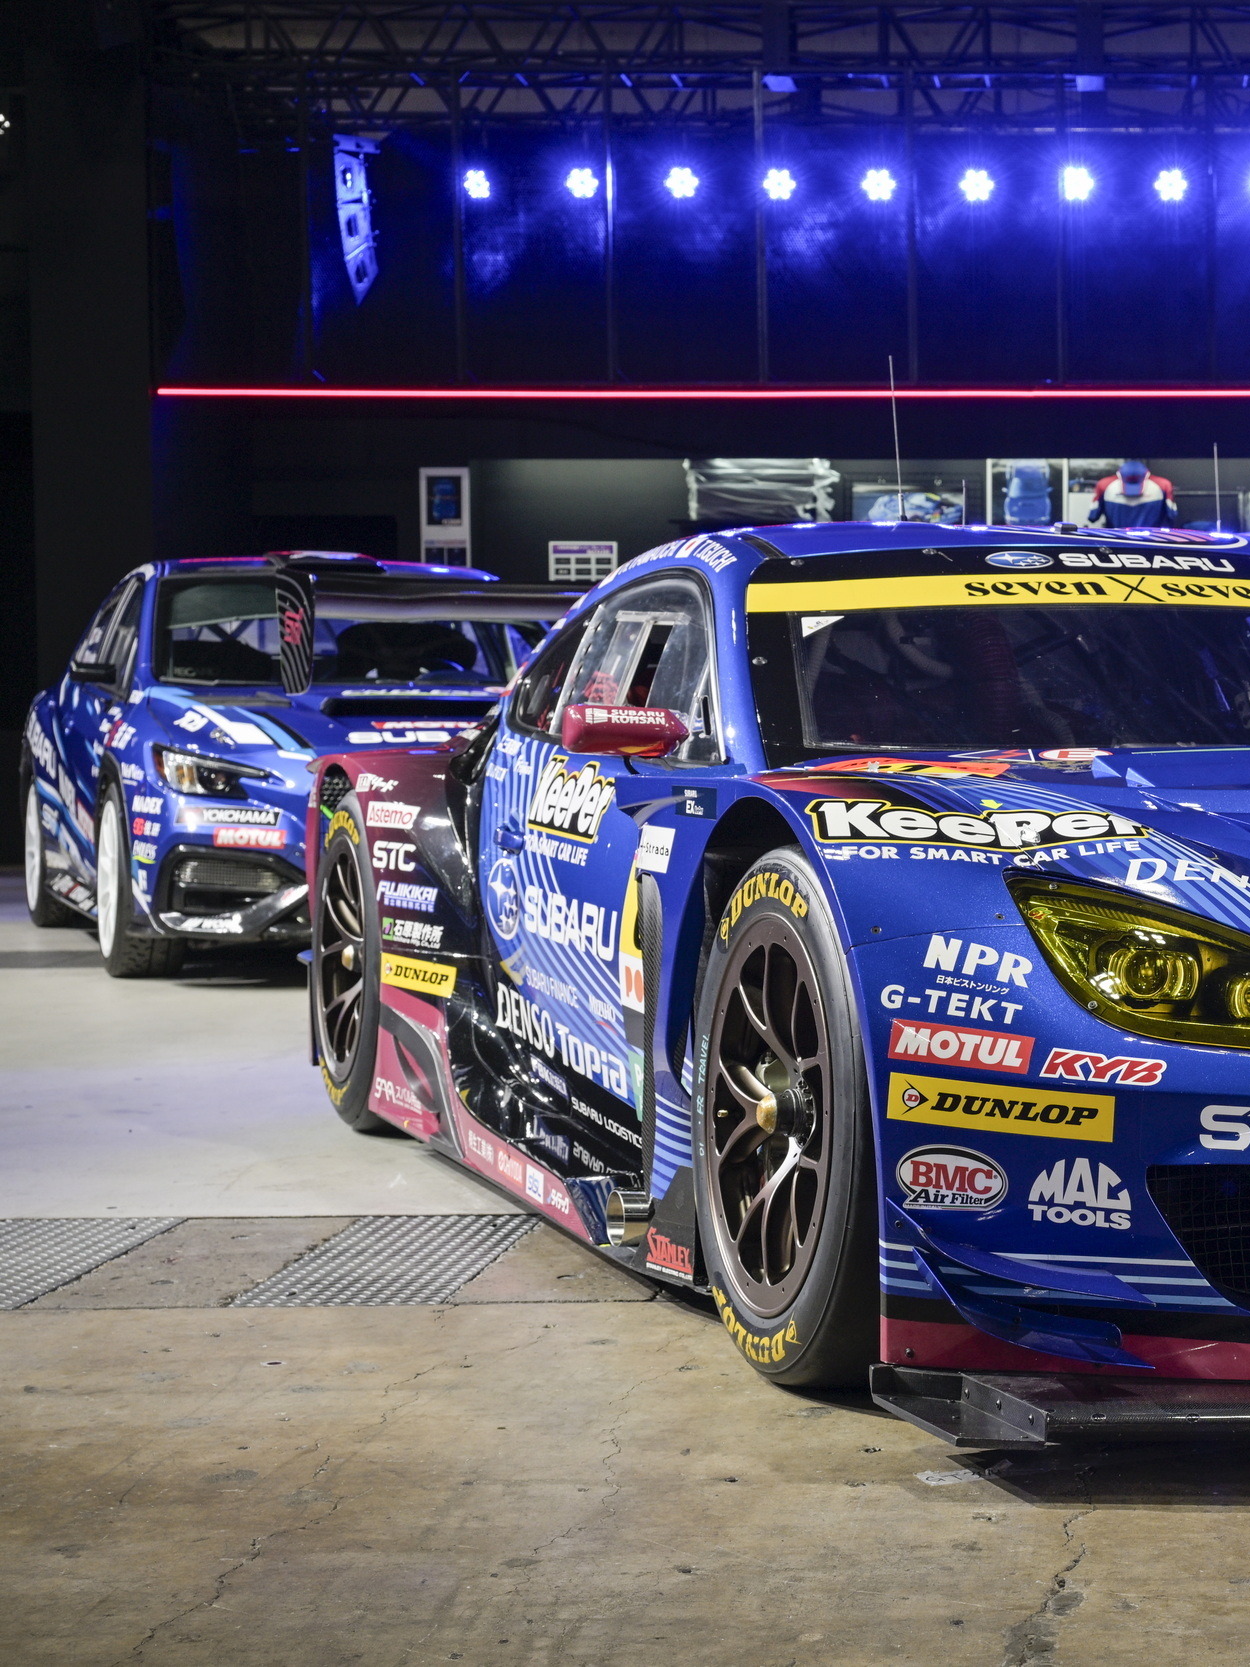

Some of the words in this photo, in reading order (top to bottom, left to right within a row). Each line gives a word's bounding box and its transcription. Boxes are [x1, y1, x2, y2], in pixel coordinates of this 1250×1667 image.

[1058, 552, 1236, 573] SUBARU
[964, 580, 1110, 597] seven
[382, 721, 479, 729] MOTU
[611, 709, 665, 717] SUBARU
[348, 731, 453, 744] SUB
[529, 757, 615, 836] KeePer
[202, 808, 275, 825] YOKOHAMA
[369, 805, 414, 825] Astemo
[818, 800, 1146, 848] KeePer
[216, 830, 281, 847] MOTUL
[842, 845, 899, 862] FOR
[910, 847, 1003, 867] SMART
[1013, 847, 1069, 867] CAR
[1078, 838, 1142, 856] LIFE
[372, 840, 417, 872] STC
[572, 846, 589, 866] LIFE
[377, 880, 439, 902] FUJIKIKAI
[731, 872, 808, 928] DUNLOP
[524, 885, 618, 962] SUBARU
[394, 966, 449, 986] DUNLOP
[923, 935, 1033, 988] NPR
[936, 974, 1010, 995] 日本ピストンリング
[880, 984, 1024, 1025] G-TEKT
[496, 981, 555, 1058] DENSO
[894, 1025, 1022, 1068] MOTUL
[1041, 1050, 1165, 1085] KYB
[571, 1096, 603, 1126] SUBARU
[930, 1091, 1099, 1126] DUNLOP
[909, 1160, 994, 1195] BMC
[1027, 1157, 1132, 1211] MAC
[909, 1189, 949, 1204] Air
[950, 1193, 986, 1205] Filter
[1027, 1204, 1132, 1230] TOOLS
[646, 1226, 693, 1275] STANLEY
